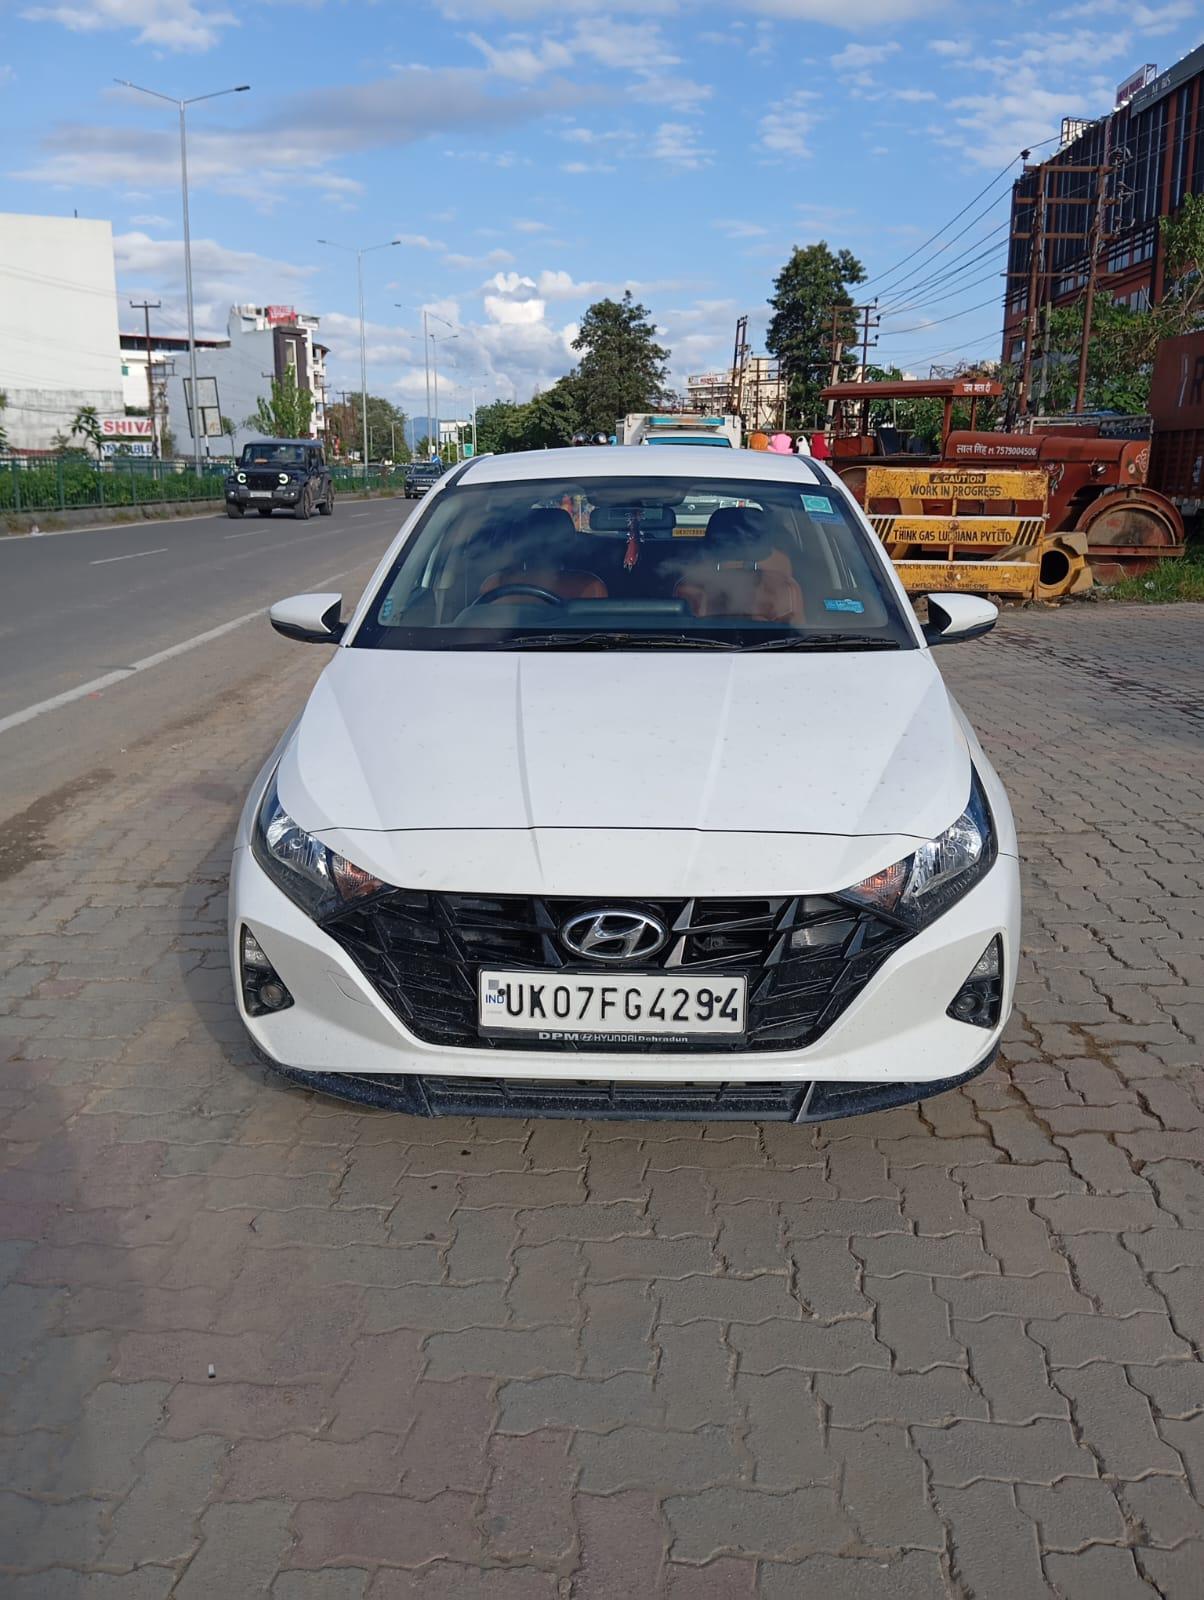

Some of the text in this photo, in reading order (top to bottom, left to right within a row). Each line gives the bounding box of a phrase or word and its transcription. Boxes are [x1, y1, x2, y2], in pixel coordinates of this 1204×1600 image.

[942, 475, 984, 483] CAUTION
[910, 485, 1002, 497] WORK IN PROGRESS
[893, 529, 917, 541] THINK
[918, 530, 936, 541] GAS
[485, 994, 505, 1005] IND
[506, 983, 738, 1022] UK07FG4294
[538, 1032, 579, 1041] DPM
[594, 1034, 638, 1043] HYUNDAI
